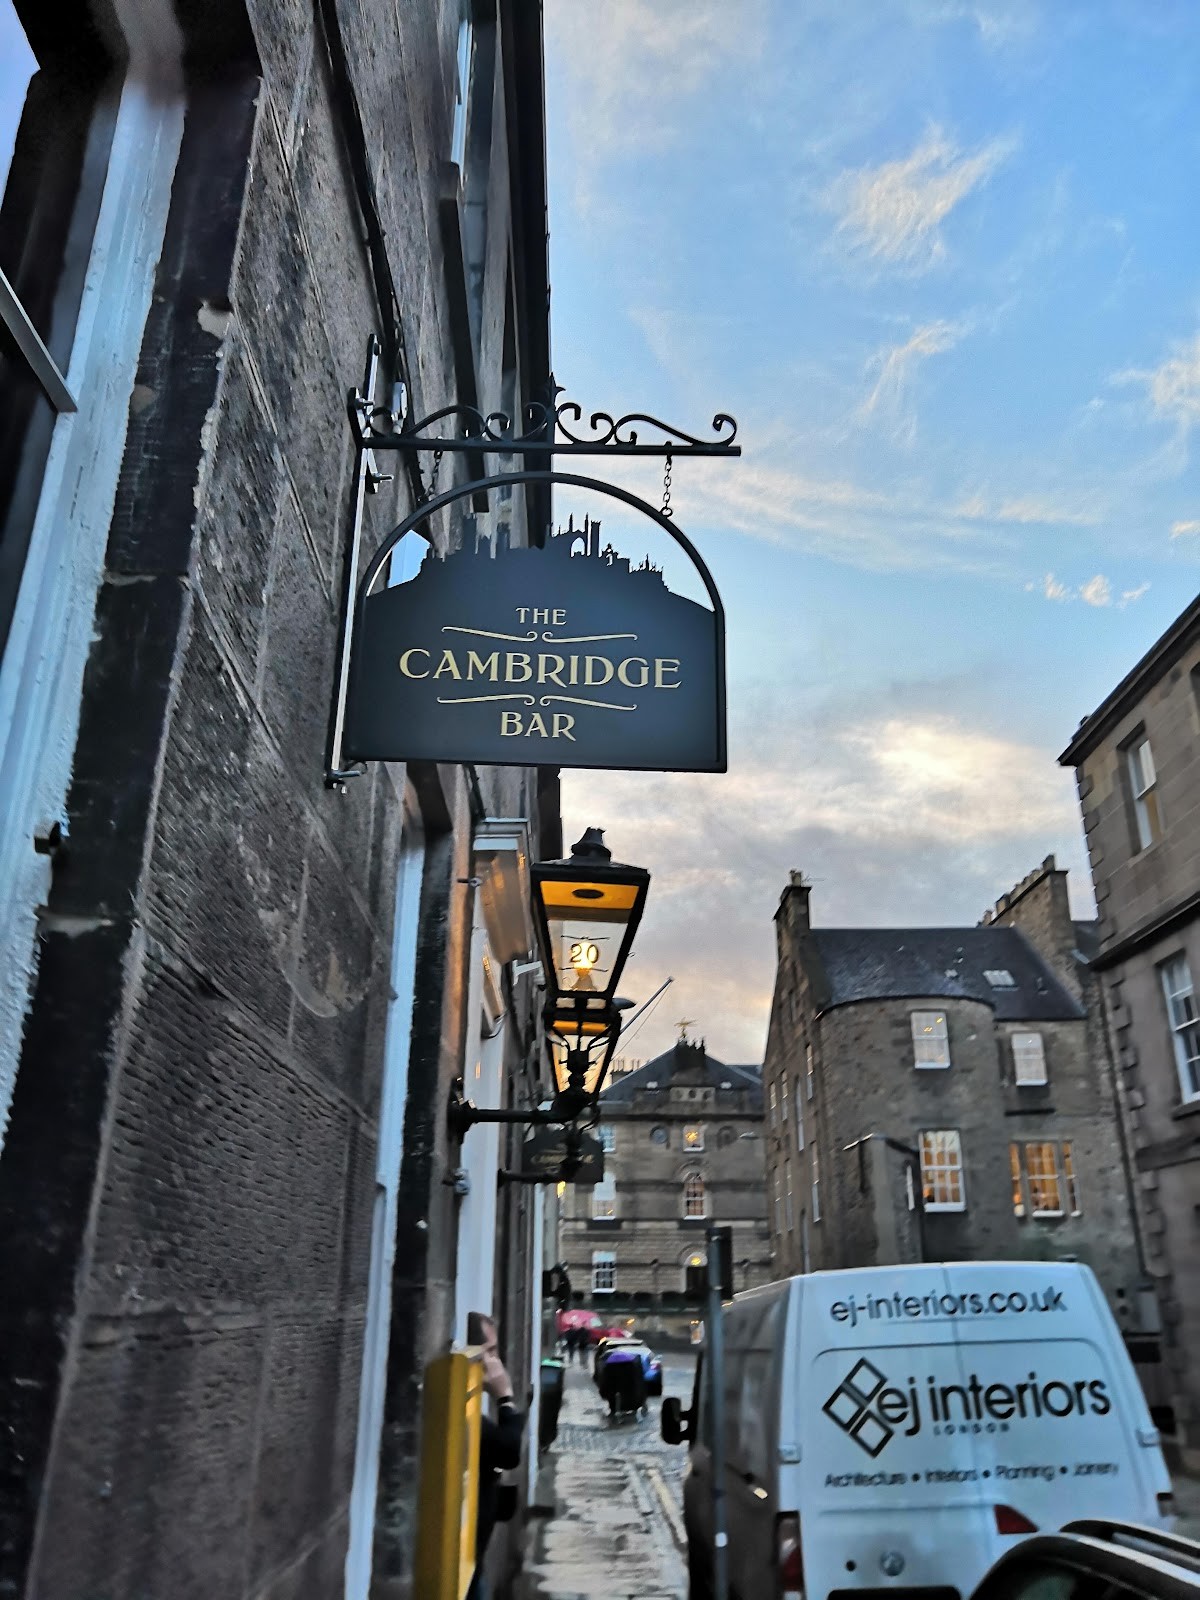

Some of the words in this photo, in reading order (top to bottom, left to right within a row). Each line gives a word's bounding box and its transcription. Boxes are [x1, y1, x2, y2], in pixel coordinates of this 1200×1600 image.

[515, 607, 567, 626] THE
[399, 648, 682, 689] CAMBRIDGE
[500, 711, 577, 741] BAR
[570, 943, 599, 963] 20
[830, 1286, 1068, 1327] ej-interiors.co.uk
[877, 1376, 921, 1436] ej
[927, 1371, 1111, 1421] interiors
[1073, 1462, 1119, 1477] Jone
